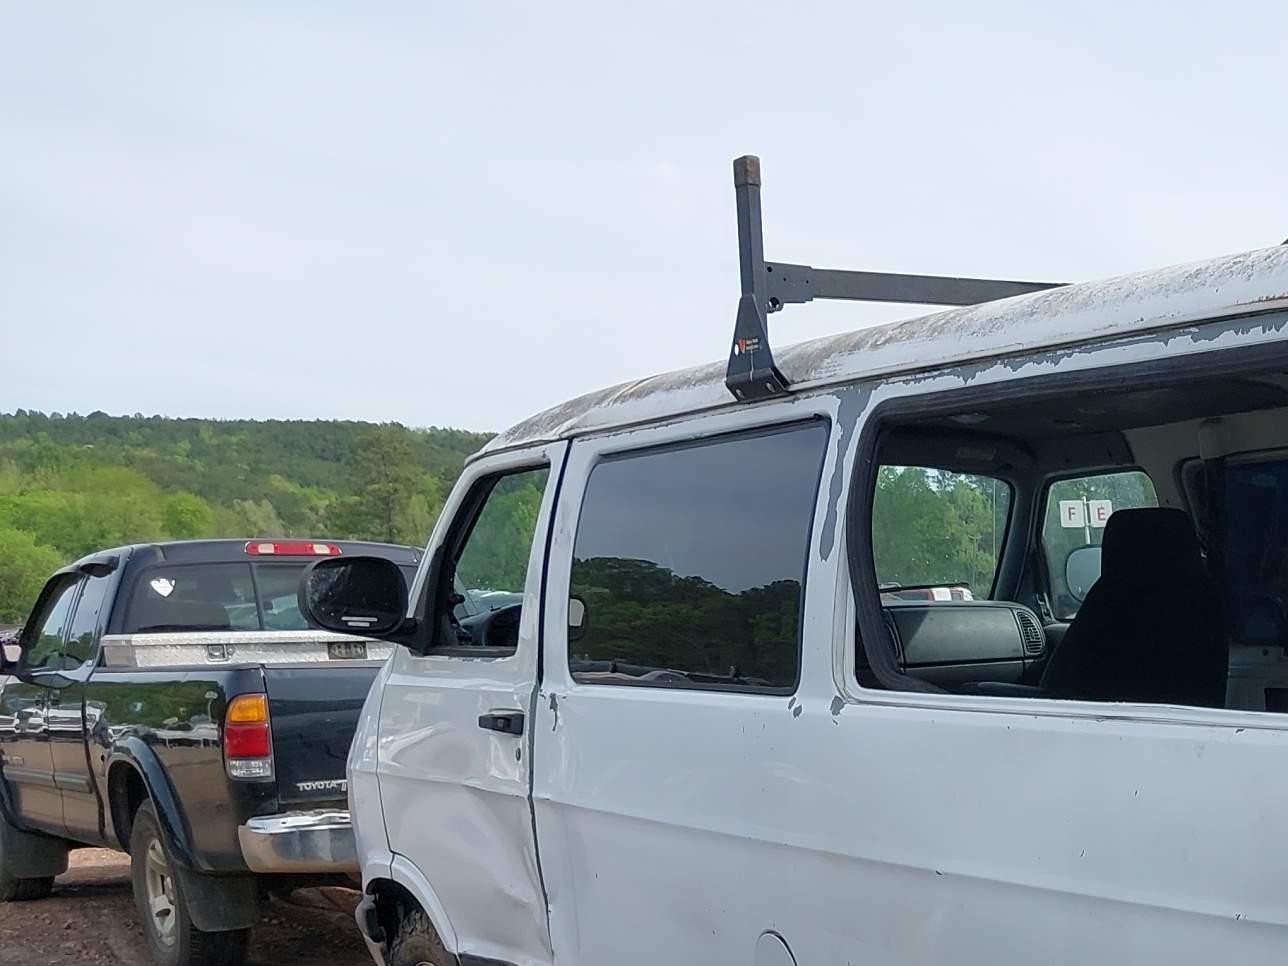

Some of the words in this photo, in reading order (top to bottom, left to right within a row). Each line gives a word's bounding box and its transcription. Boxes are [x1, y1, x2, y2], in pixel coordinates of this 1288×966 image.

[1067, 506, 1077, 521] F
[1096, 506, 1106, 521] E
[296, 780, 337, 792] TOYOTA
